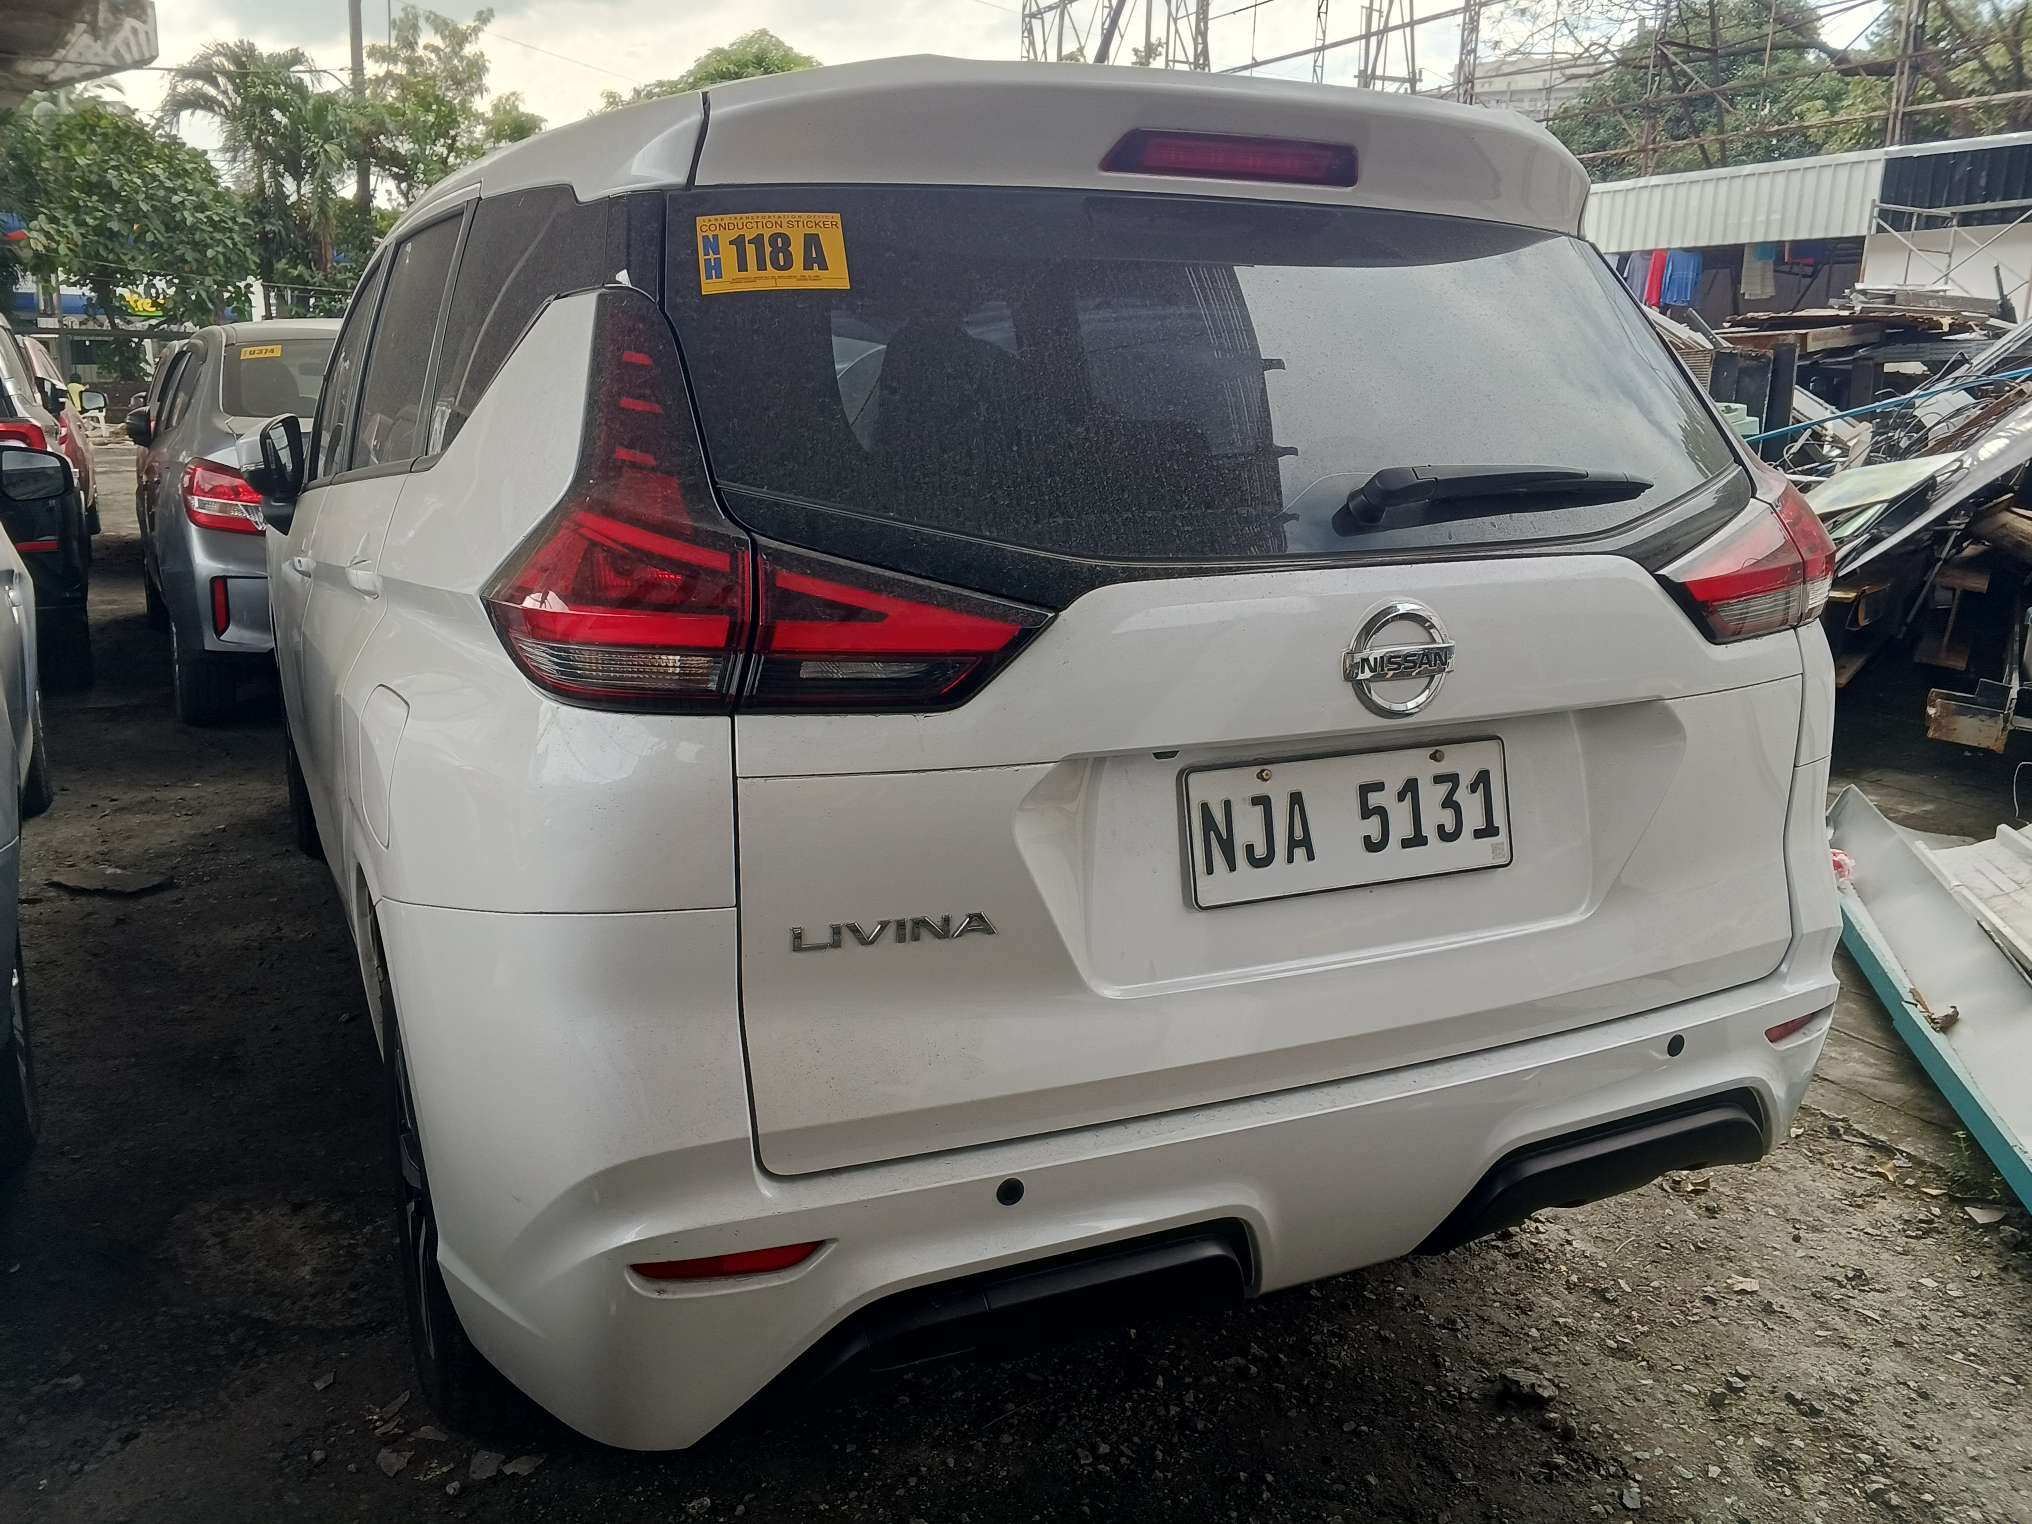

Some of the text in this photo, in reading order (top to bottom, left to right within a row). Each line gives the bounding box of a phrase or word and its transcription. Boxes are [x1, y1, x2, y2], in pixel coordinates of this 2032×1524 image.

[700, 220, 839, 232] CONDUCTION STICKER
[729, 232, 794, 273] 118
[803, 233, 829, 271] A
[1359, 650, 1449, 675] NISSAN
[1200, 768, 1501, 876] NJA 5131
[791, 911, 999, 952] LIVINA
